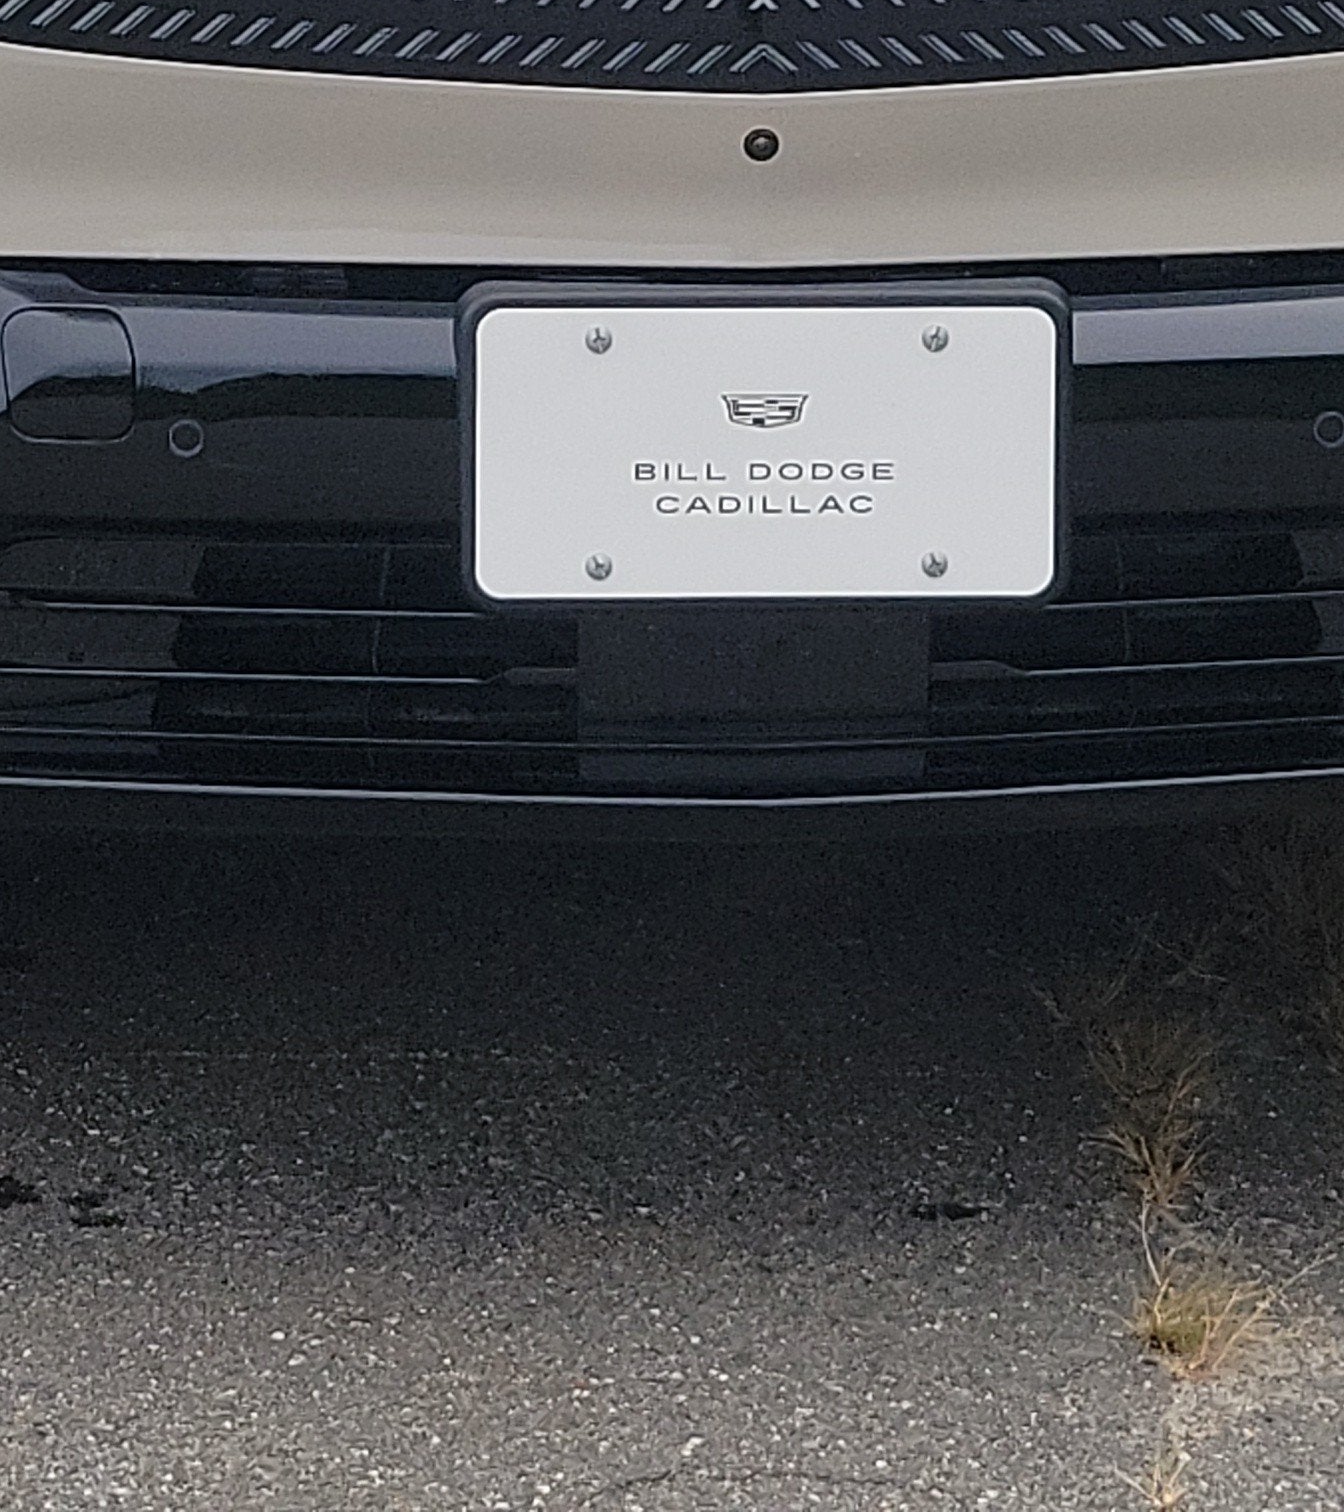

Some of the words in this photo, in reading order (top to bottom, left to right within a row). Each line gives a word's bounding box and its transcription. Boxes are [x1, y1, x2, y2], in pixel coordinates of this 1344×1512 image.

[634, 463, 726, 481] BILL
[749, 462, 894, 481] DODGE
[656, 495, 873, 514] CADILLAC
